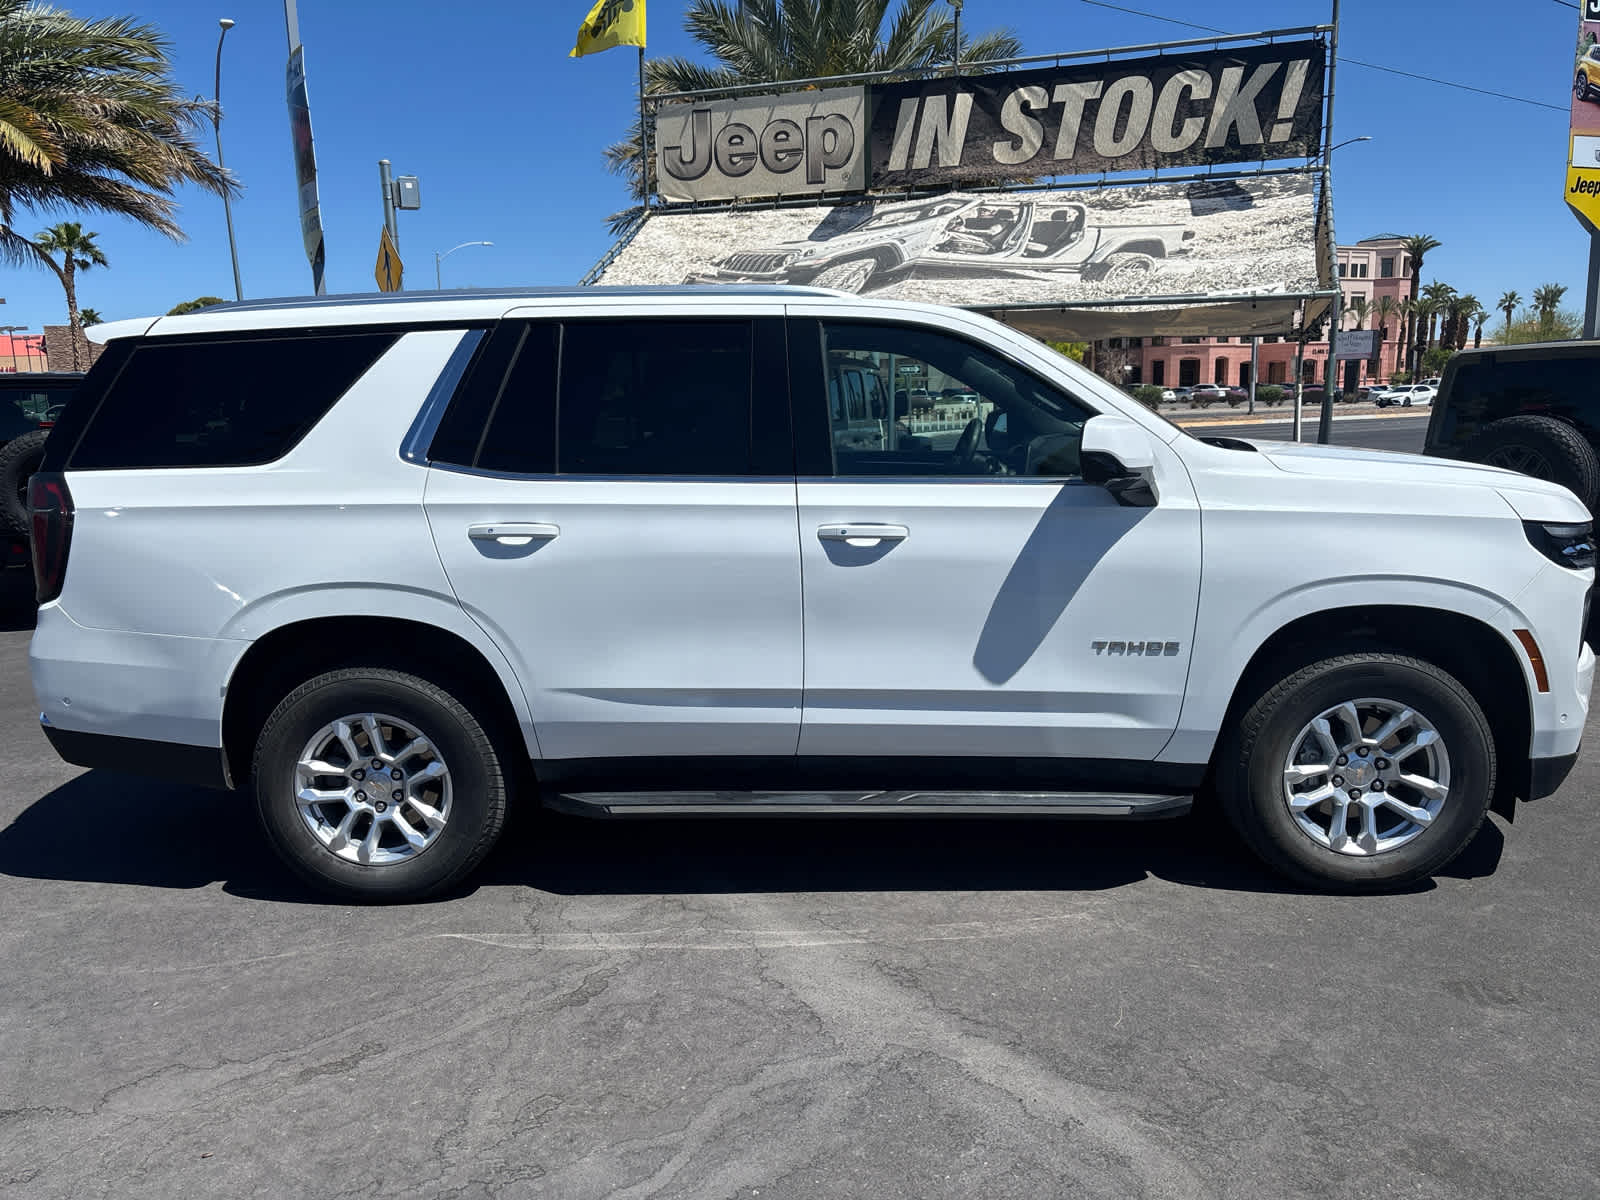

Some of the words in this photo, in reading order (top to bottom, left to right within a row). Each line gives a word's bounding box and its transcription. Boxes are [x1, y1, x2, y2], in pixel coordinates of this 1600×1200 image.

[663, 109, 855, 184] Jeep
[888, 92, 975, 171] IN
[992, 59, 1310, 165] STOCK!
[1091, 641, 1180, 656] TAHOE
